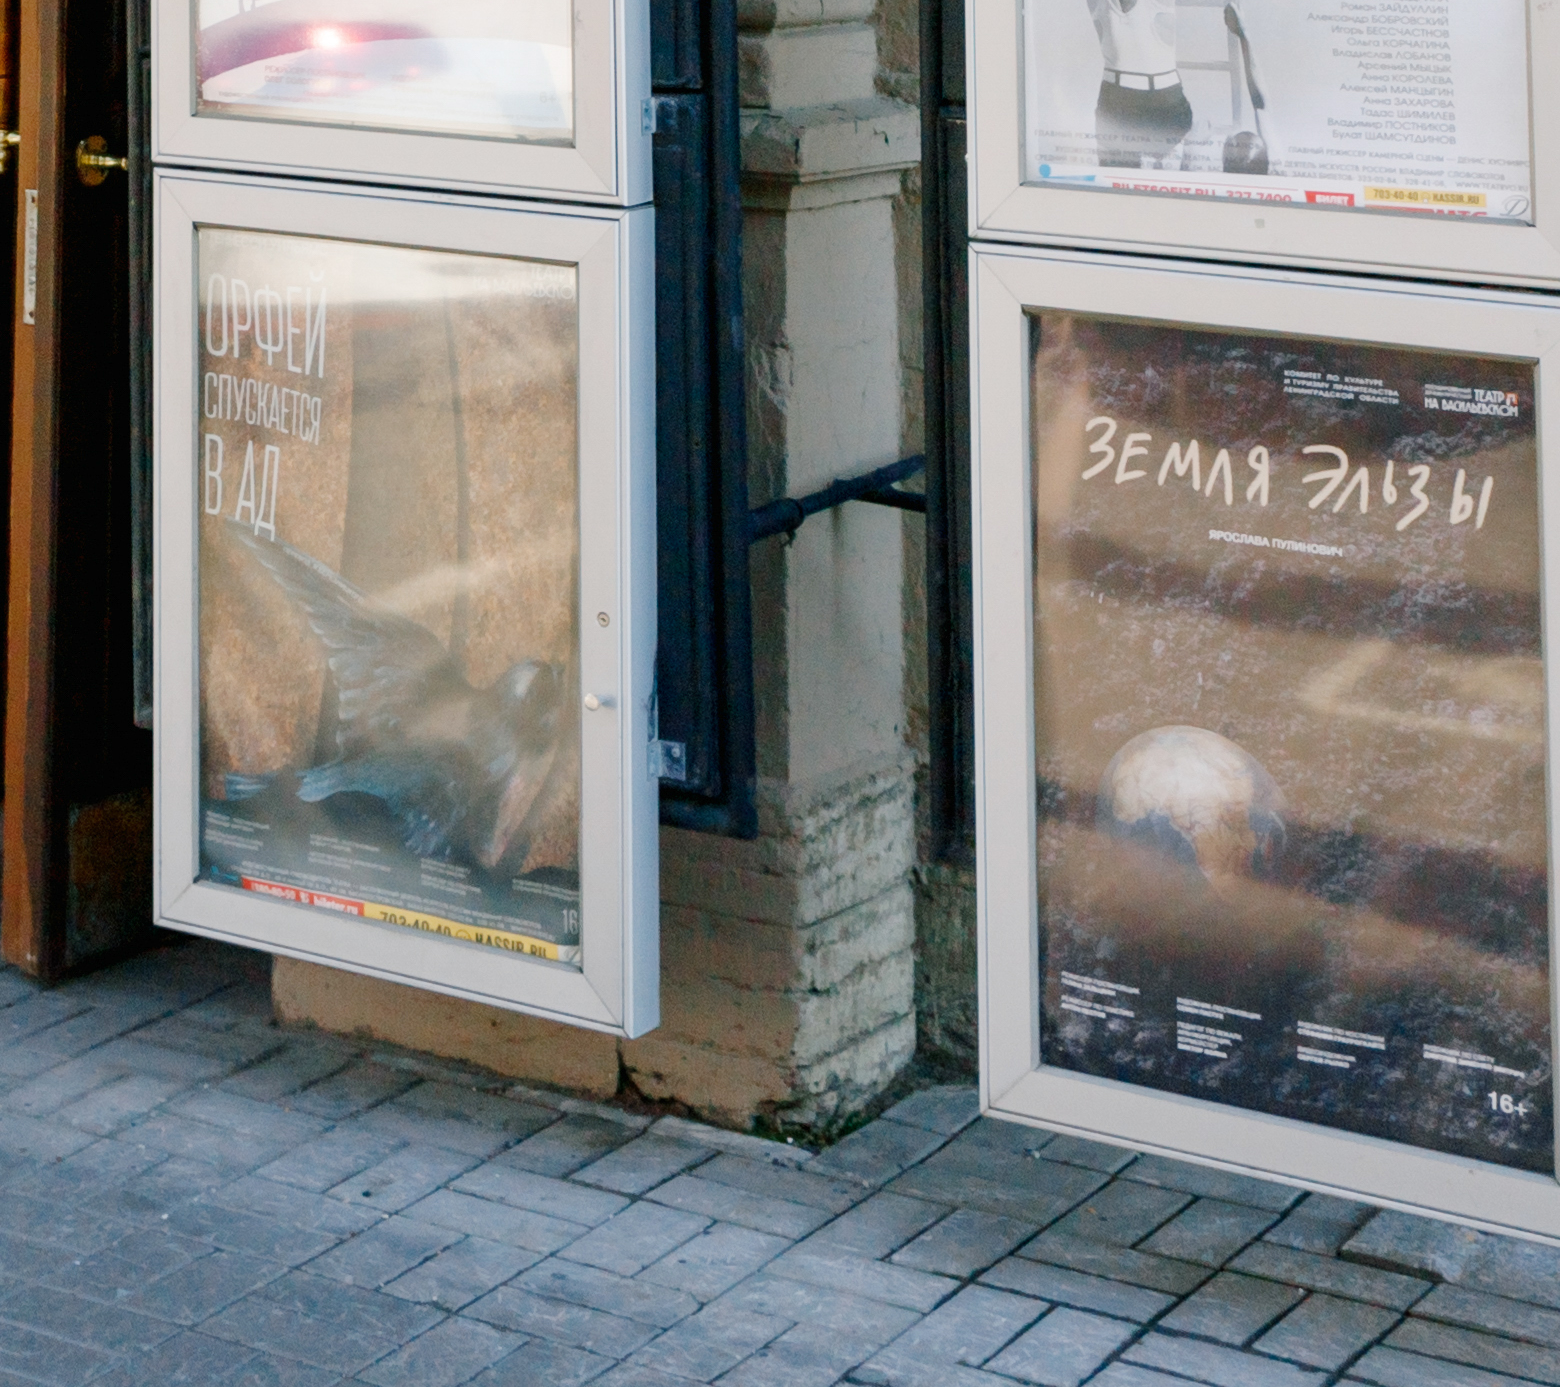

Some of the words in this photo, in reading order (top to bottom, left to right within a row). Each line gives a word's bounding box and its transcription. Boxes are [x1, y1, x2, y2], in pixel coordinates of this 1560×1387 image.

[1341, 3, 1376, 11] Роман
[1307, 13, 1369, 24] Александр
[1331, 25, 1364, 35] Игорь
[1347, 37, 1380, 47] Ольга
[1333, 49, 1392, 59] Владислав
[1358, 61, 1407, 71] Арсений
[1340, 84, 1387, 93] Алексей
[205, 270, 327, 378] ОРФЕЙ
[1474, 389, 1504, 403] ТЕАТР
[204, 372, 322, 446] СПУСКАЕТСЯ
[1081, 415, 1270, 507] ЗЕМЛЯ
[1300, 444, 1493, 532] ЭЛЬЗЫ
[204, 433, 223, 516] В
[235, 439, 280, 542] АД
[1208, 528, 1269, 549] ЯРОСЛАВА
[1272, 537, 1343, 558] ПУЛИНОВИЧ
[1488, 1091, 1528, 1116] 16+
